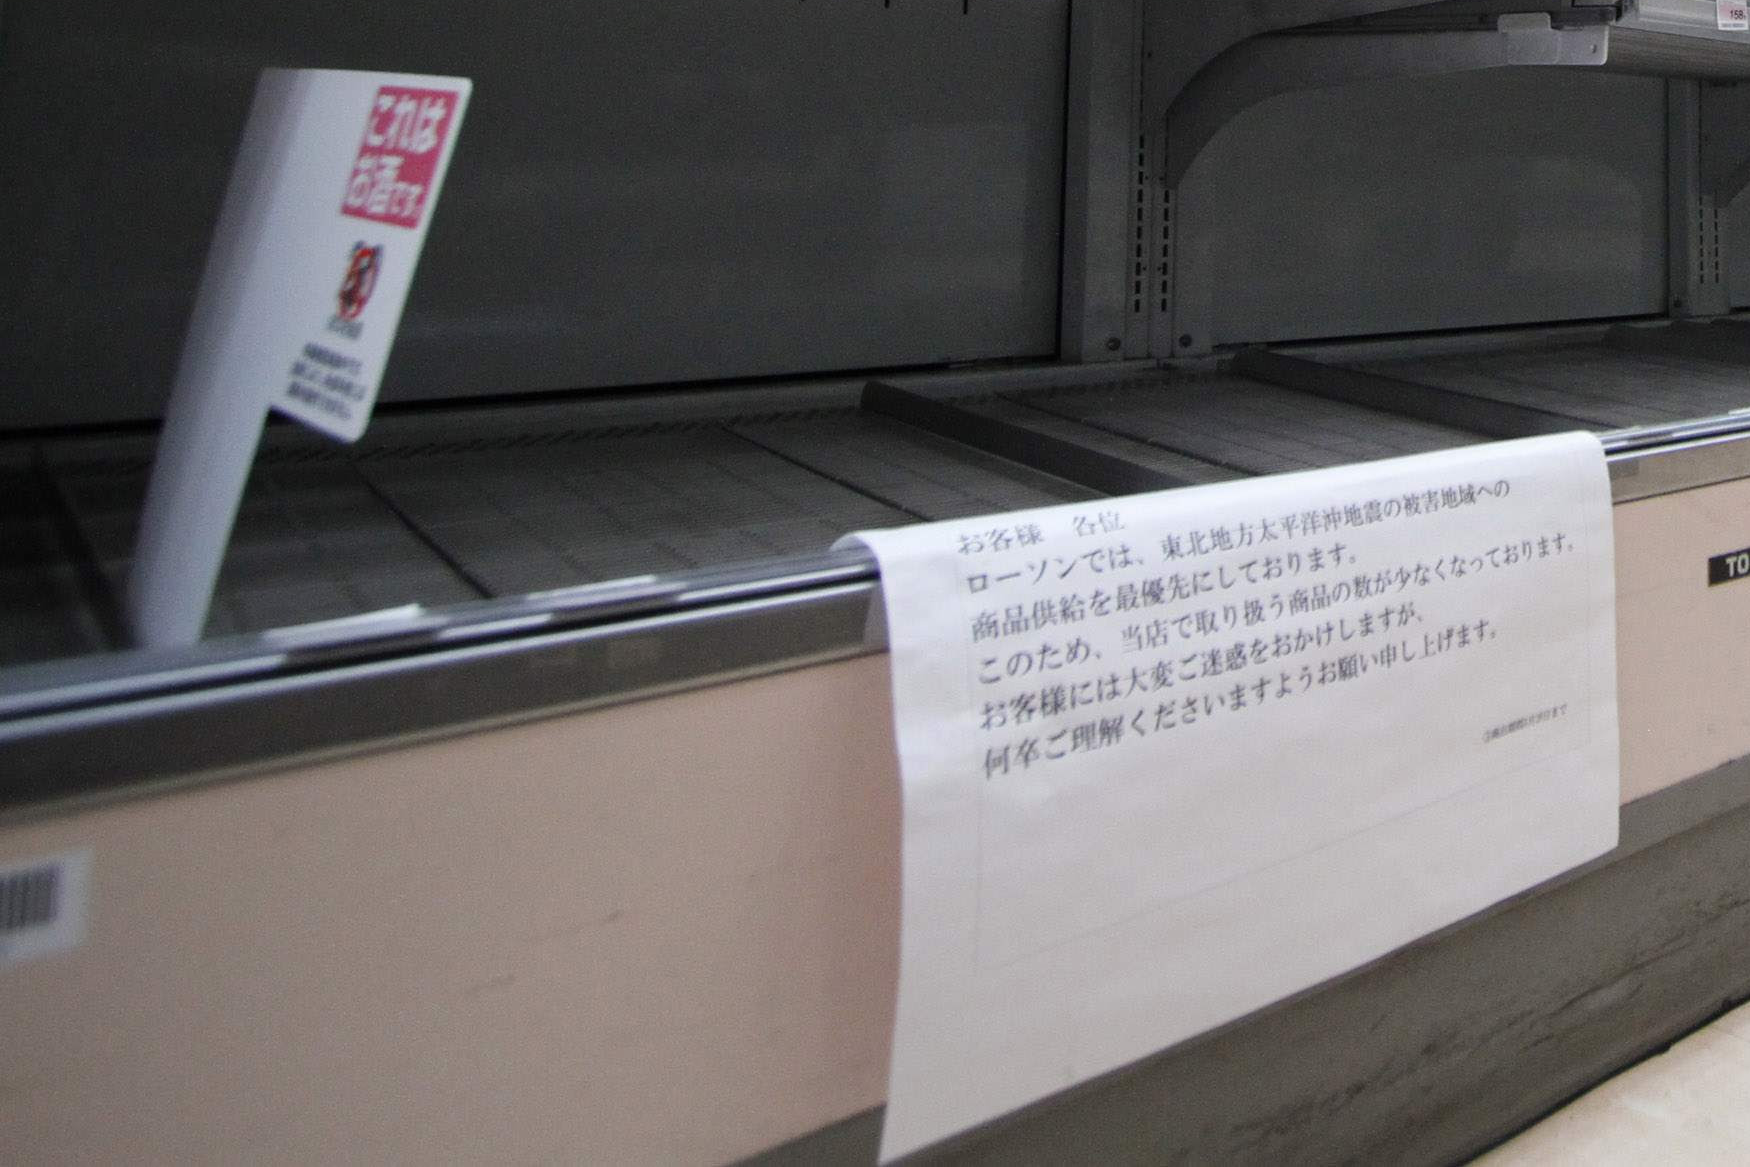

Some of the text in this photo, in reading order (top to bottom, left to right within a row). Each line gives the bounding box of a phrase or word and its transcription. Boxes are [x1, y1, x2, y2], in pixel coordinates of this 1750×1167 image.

[957, 510, 1125, 555] お客様 各位
